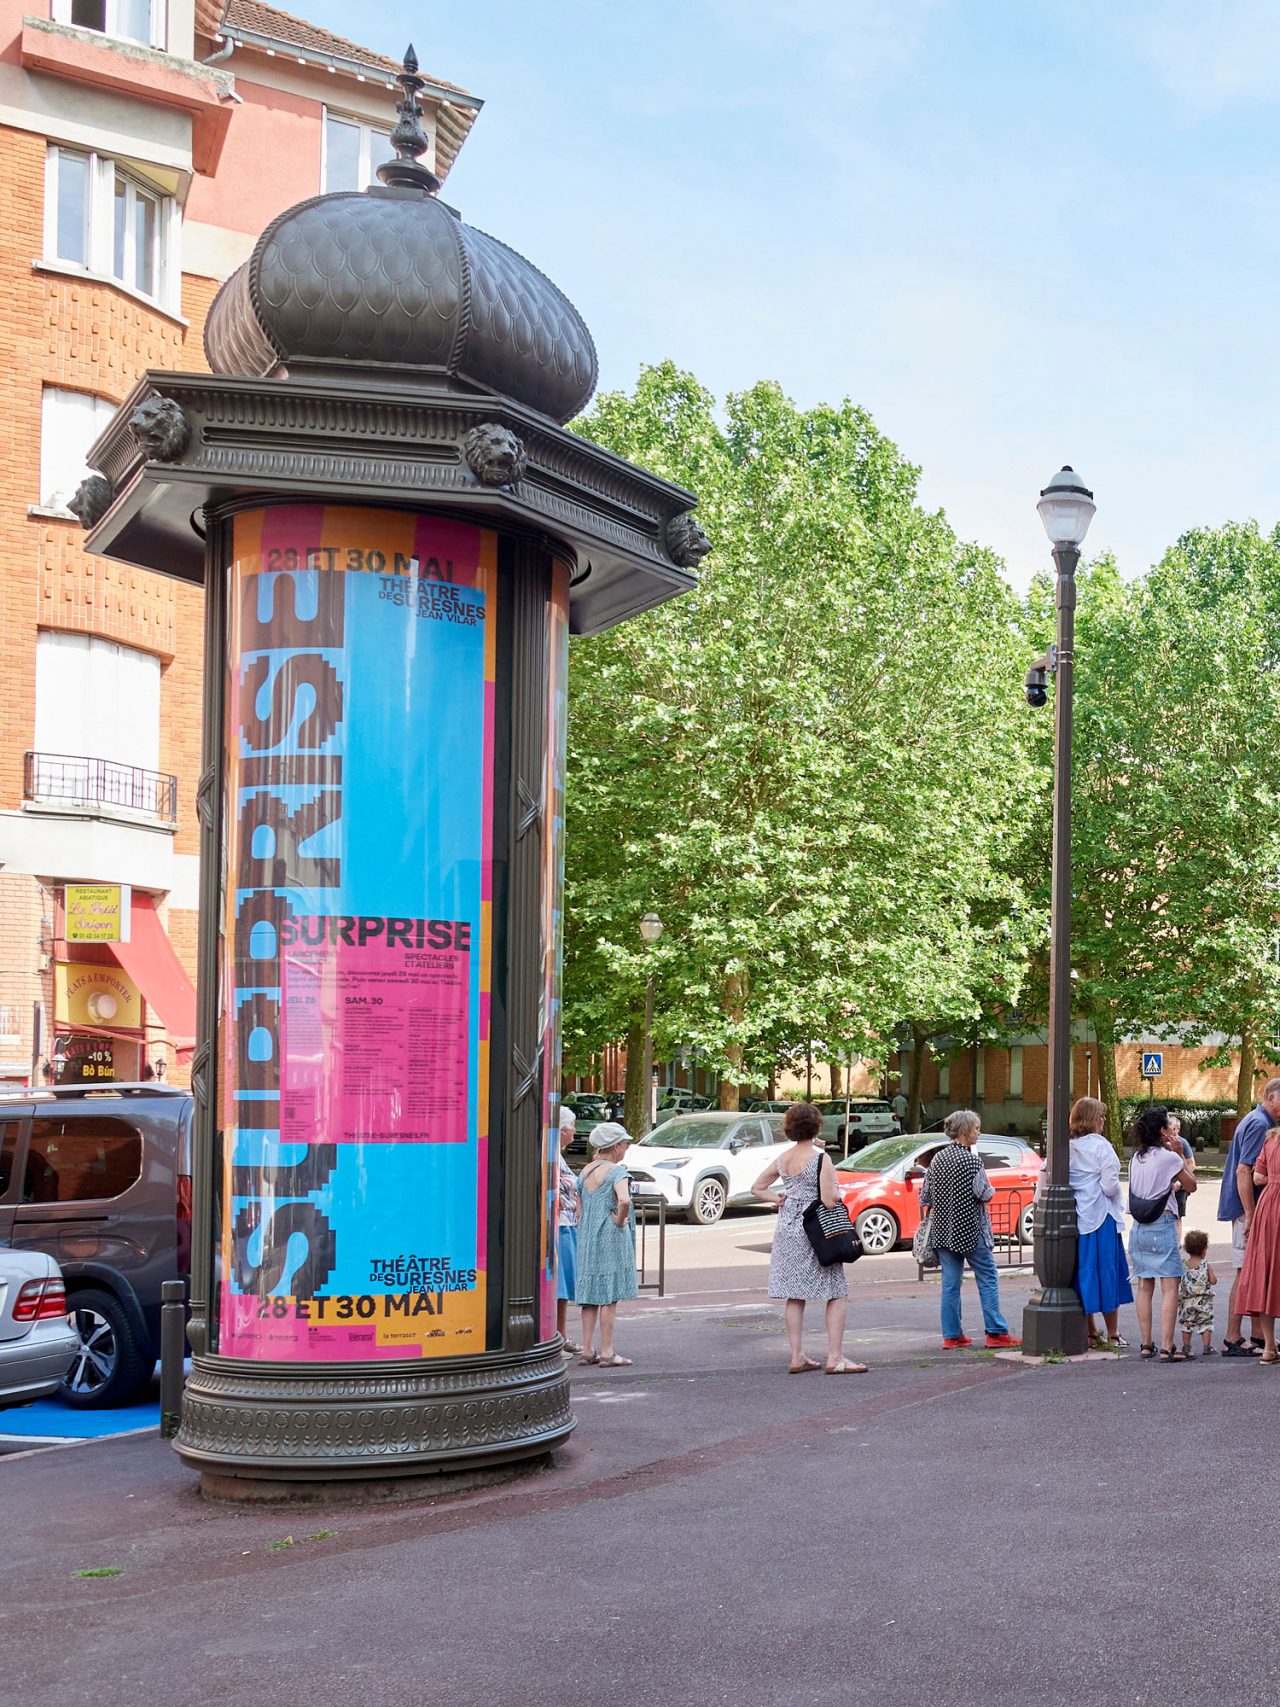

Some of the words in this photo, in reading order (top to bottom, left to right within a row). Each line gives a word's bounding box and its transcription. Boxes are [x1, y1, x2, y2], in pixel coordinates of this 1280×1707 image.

[267, 547, 298, 572] 28
[306, 547, 341, 572] ET
[346, 548, 387, 573] 30
[394, 552, 454, 584] MAI
[379, 575, 461, 602] THÉÂTRE
[379, 590, 393, 600] DE
[393, 592, 486, 621] SURESNES
[416, 609, 443, 622] JEAN
[446, 613, 478, 627] VILAR
[68, 902, 86, 915] Le
[281, 915, 471, 951] SURPRISE
[404, 952, 459, 962] SPECTACLES
[404, 960, 414, 968] ET
[416, 961, 455, 970] ATELIERS
[65, 975, 87, 999] PLATS
[93, 973, 133, 1003] EMPORTER
[344, 997, 369, 1005] SAM.
[370, 997, 383, 1005] 30
[88, 1051, 103, 1062] -10
[104, 1050, 112, 1062] %
[83, 1064, 95, 1077] Bò
[370, 1254, 451, 1273] THÉÂTRE
[369, 1273, 384, 1282] DE
[384, 1269, 478, 1287] SURESNES
[406, 1285, 435, 1294] JEAN
[437, 1283, 468, 1292] VILAR
[257, 1295, 288, 1319] 28
[295, 1295, 332, 1319] ET
[336, 1294, 377, 1319] 30
[384, 1291, 443, 1318] MAI
